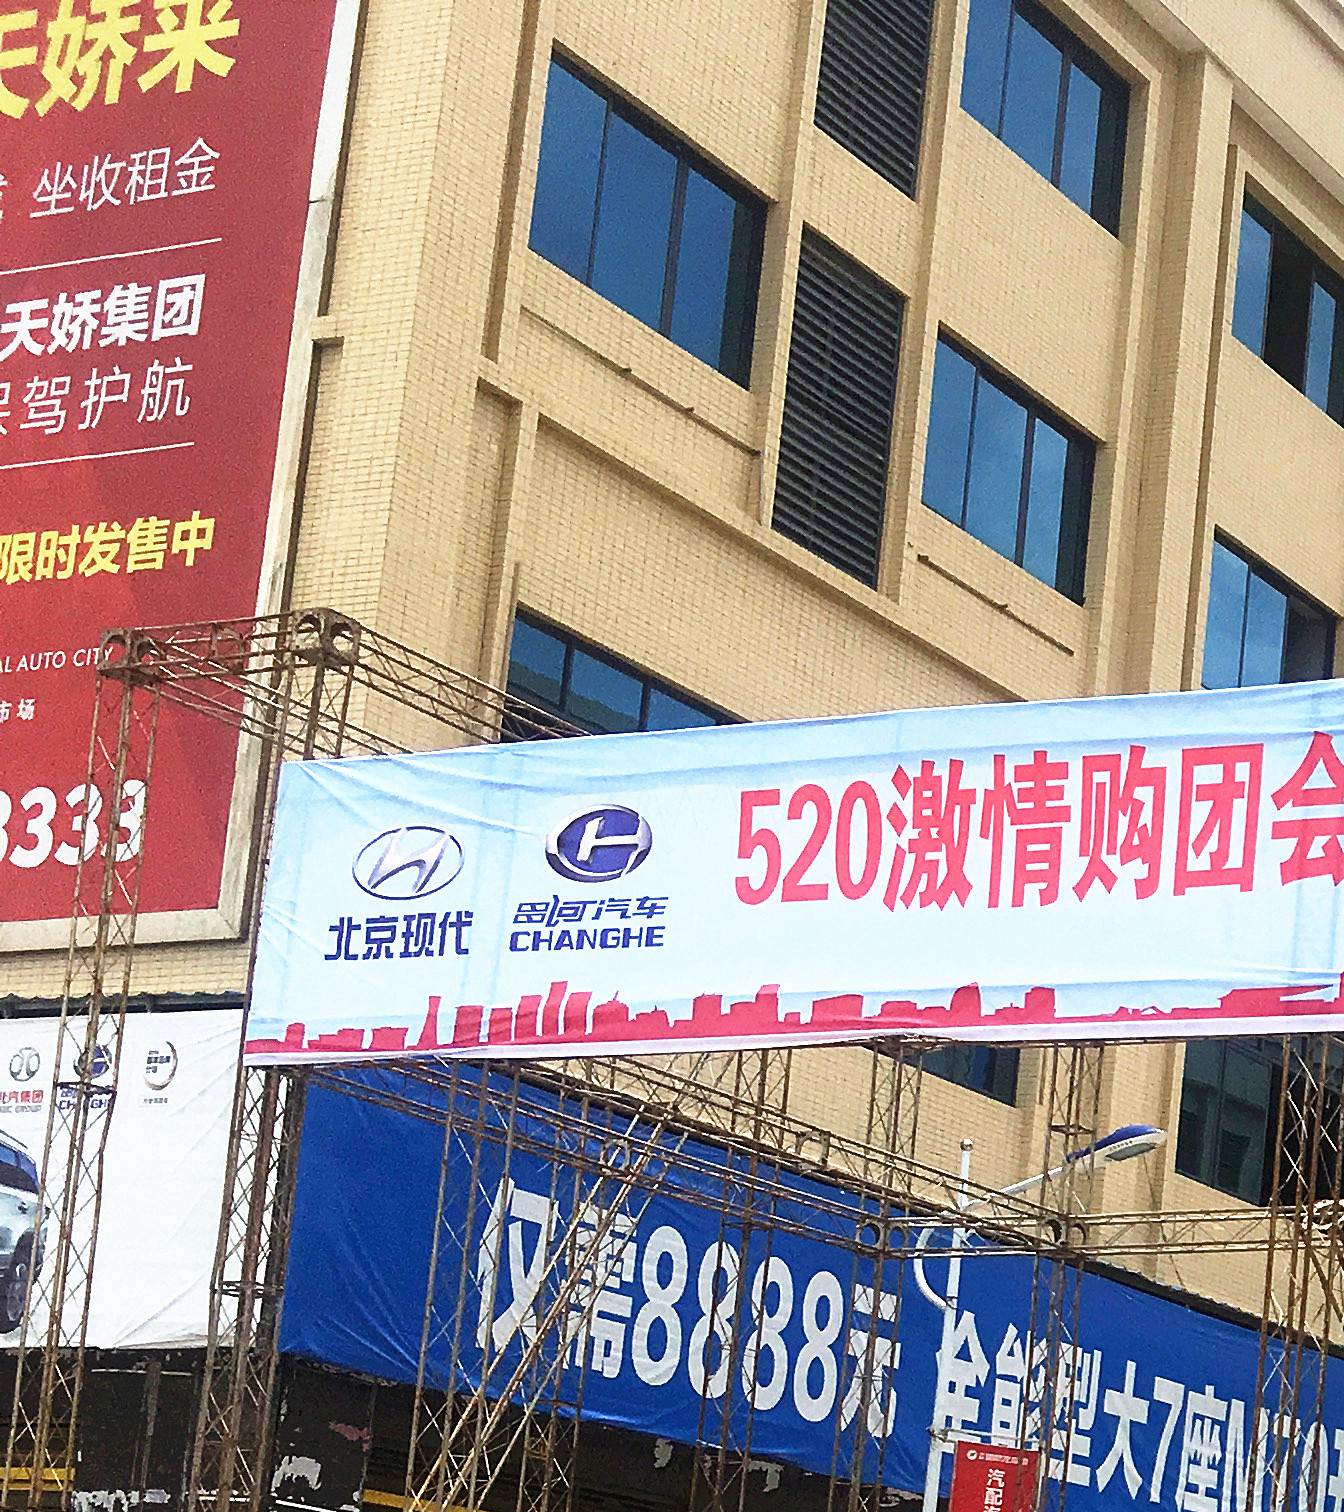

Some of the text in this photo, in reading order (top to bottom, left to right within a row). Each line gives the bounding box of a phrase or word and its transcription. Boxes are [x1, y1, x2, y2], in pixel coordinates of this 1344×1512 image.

[30, 137, 221, 218] 坐收租金
[0, 274, 206, 362] 天娇集团
[0, 510, 215, 585] 限时发售中
[16, 650, 66, 672] AUTO
[73, 646, 114, 668] CITY
[0, 779, 147, 868] 333
[324, 910, 474, 961] 北京现代
[509, 925, 666, 952] CHANGHE
[512, 895, 668, 925] 昌河汽车
